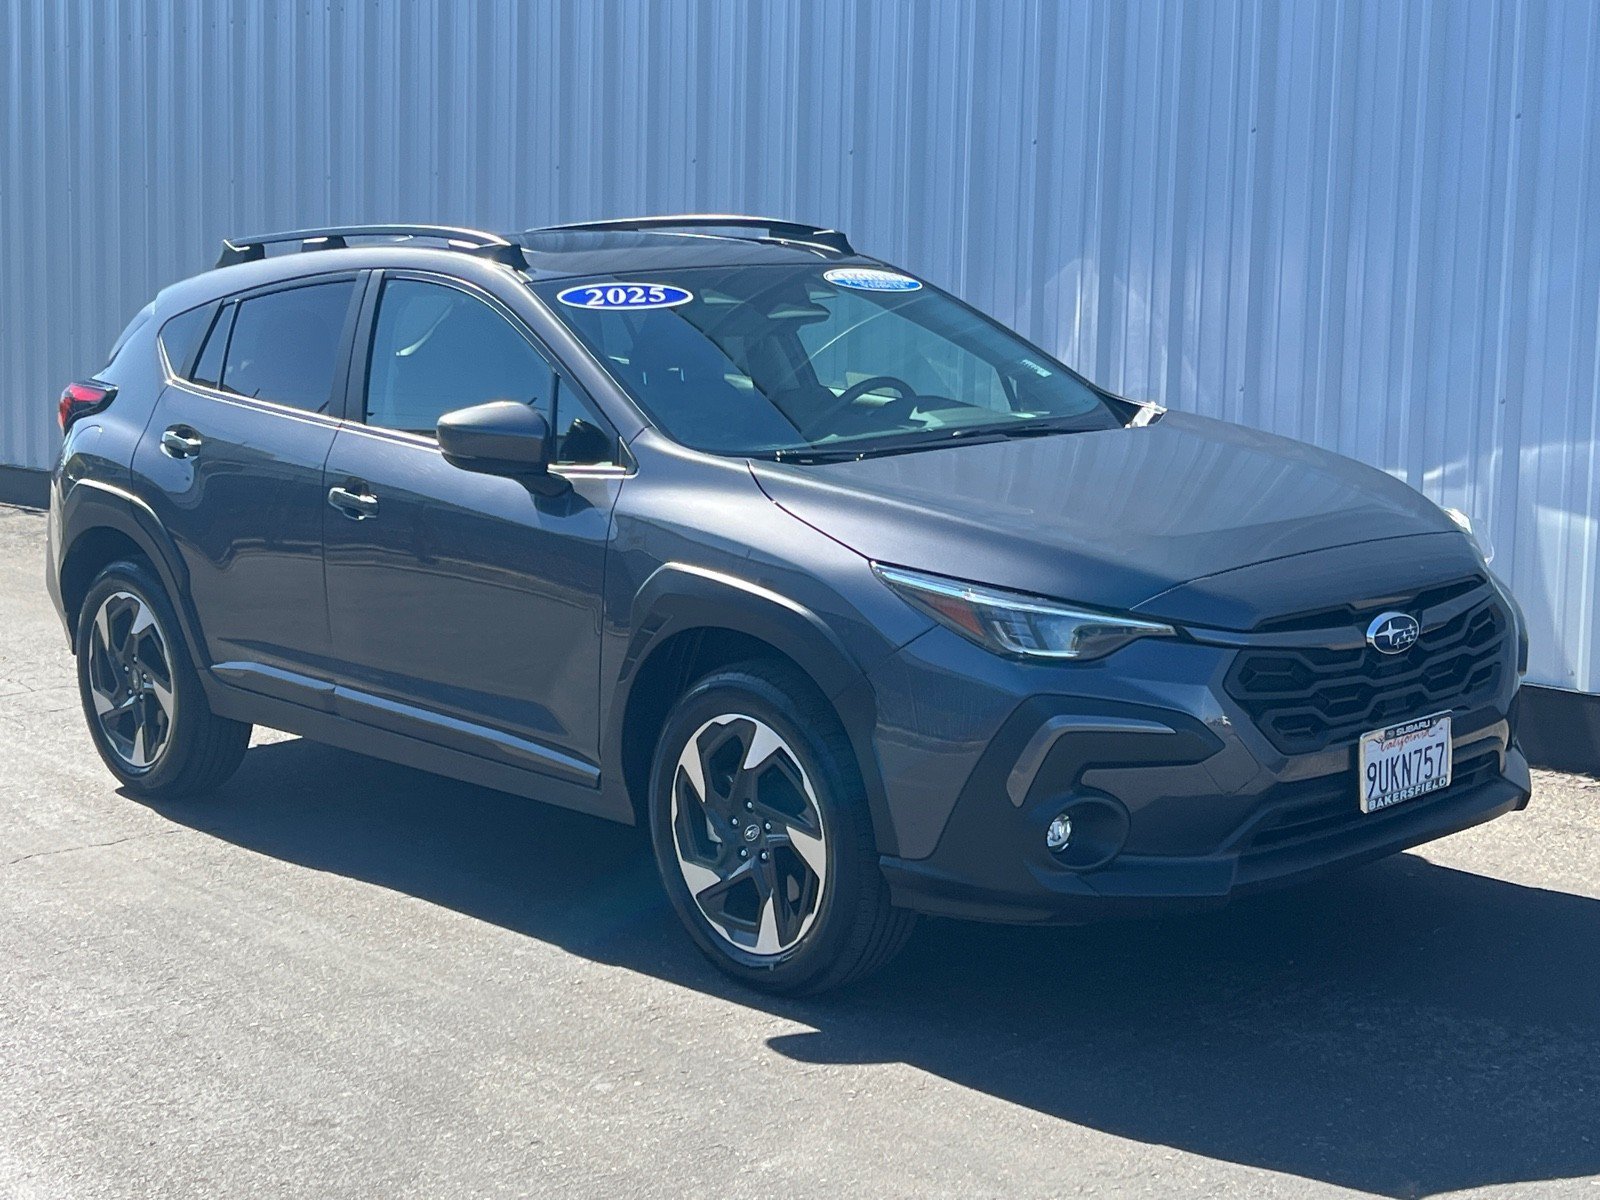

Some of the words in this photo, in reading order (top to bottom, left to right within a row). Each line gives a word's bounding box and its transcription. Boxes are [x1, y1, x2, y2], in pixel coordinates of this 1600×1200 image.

[585, 287, 666, 306] 2025
[1395, 719, 1431, 737] SUBARU
[1367, 742, 1445, 799] 9UKN757
[1368, 776, 1447, 811] BAKERSFIELD
